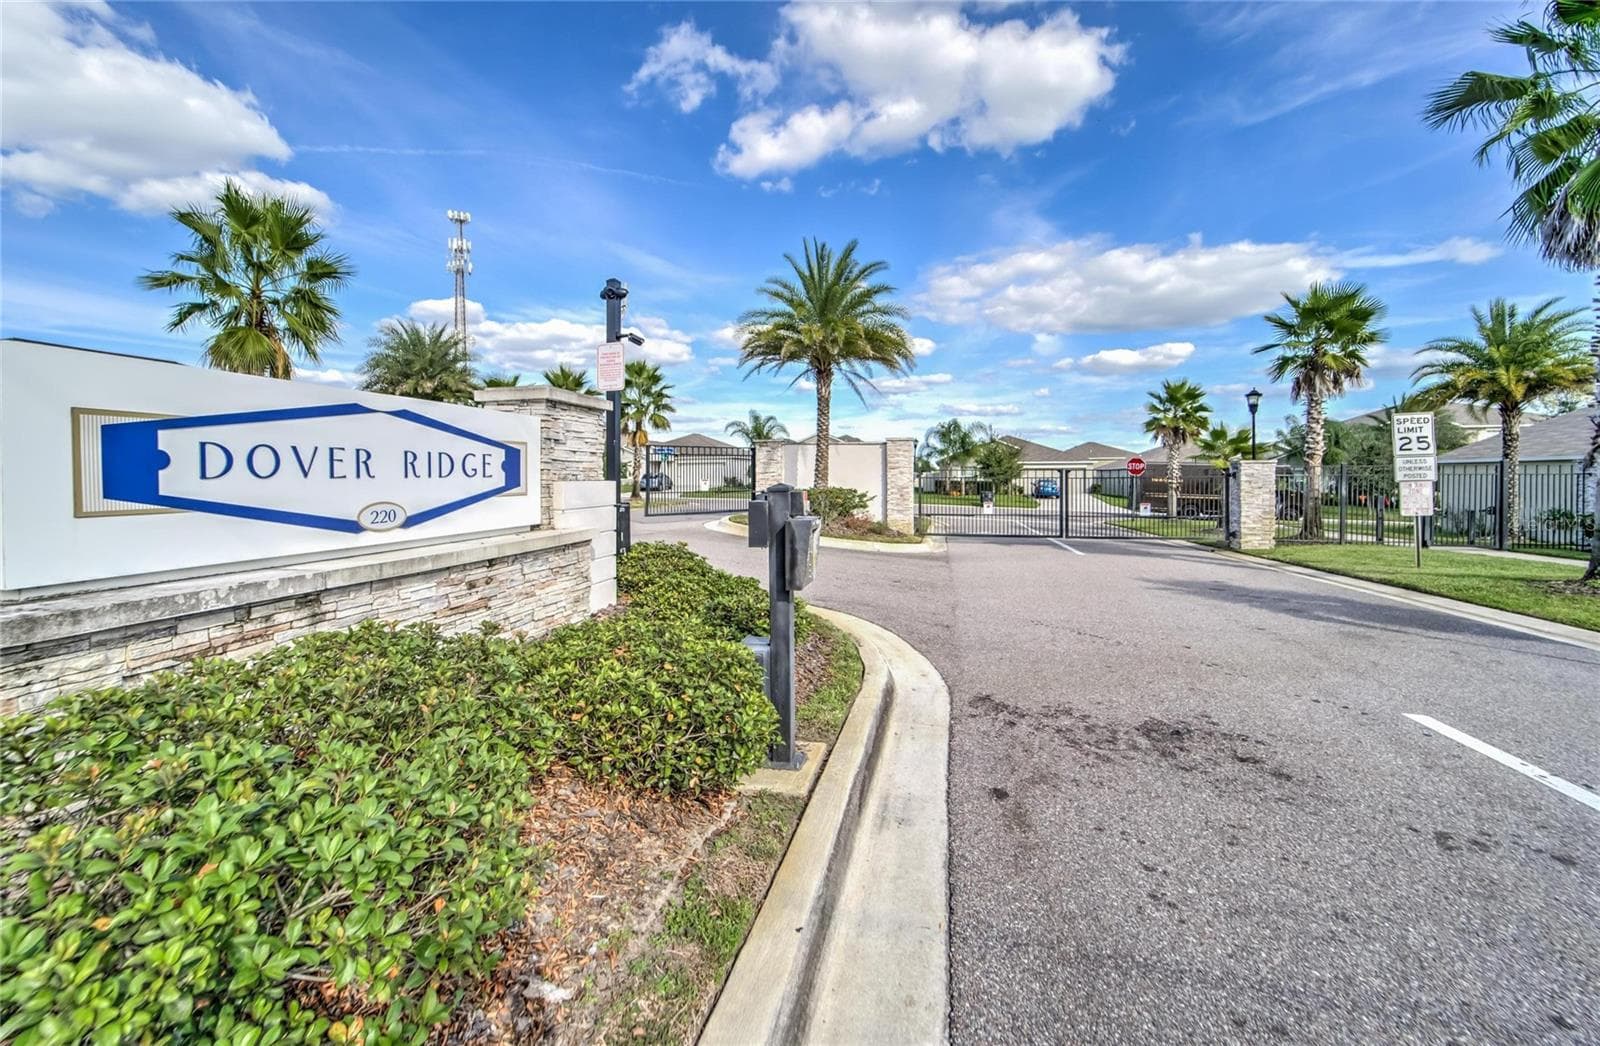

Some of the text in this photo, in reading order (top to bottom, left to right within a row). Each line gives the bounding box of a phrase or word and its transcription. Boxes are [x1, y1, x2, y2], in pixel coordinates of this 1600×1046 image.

[1395, 416, 1431, 425] SPEED
[1397, 426, 1424, 434] LIMIT
[1398, 435, 1431, 452] 25
[199, 441, 493, 480] DOVER RIDGE
[370, 508, 397, 525] 220
